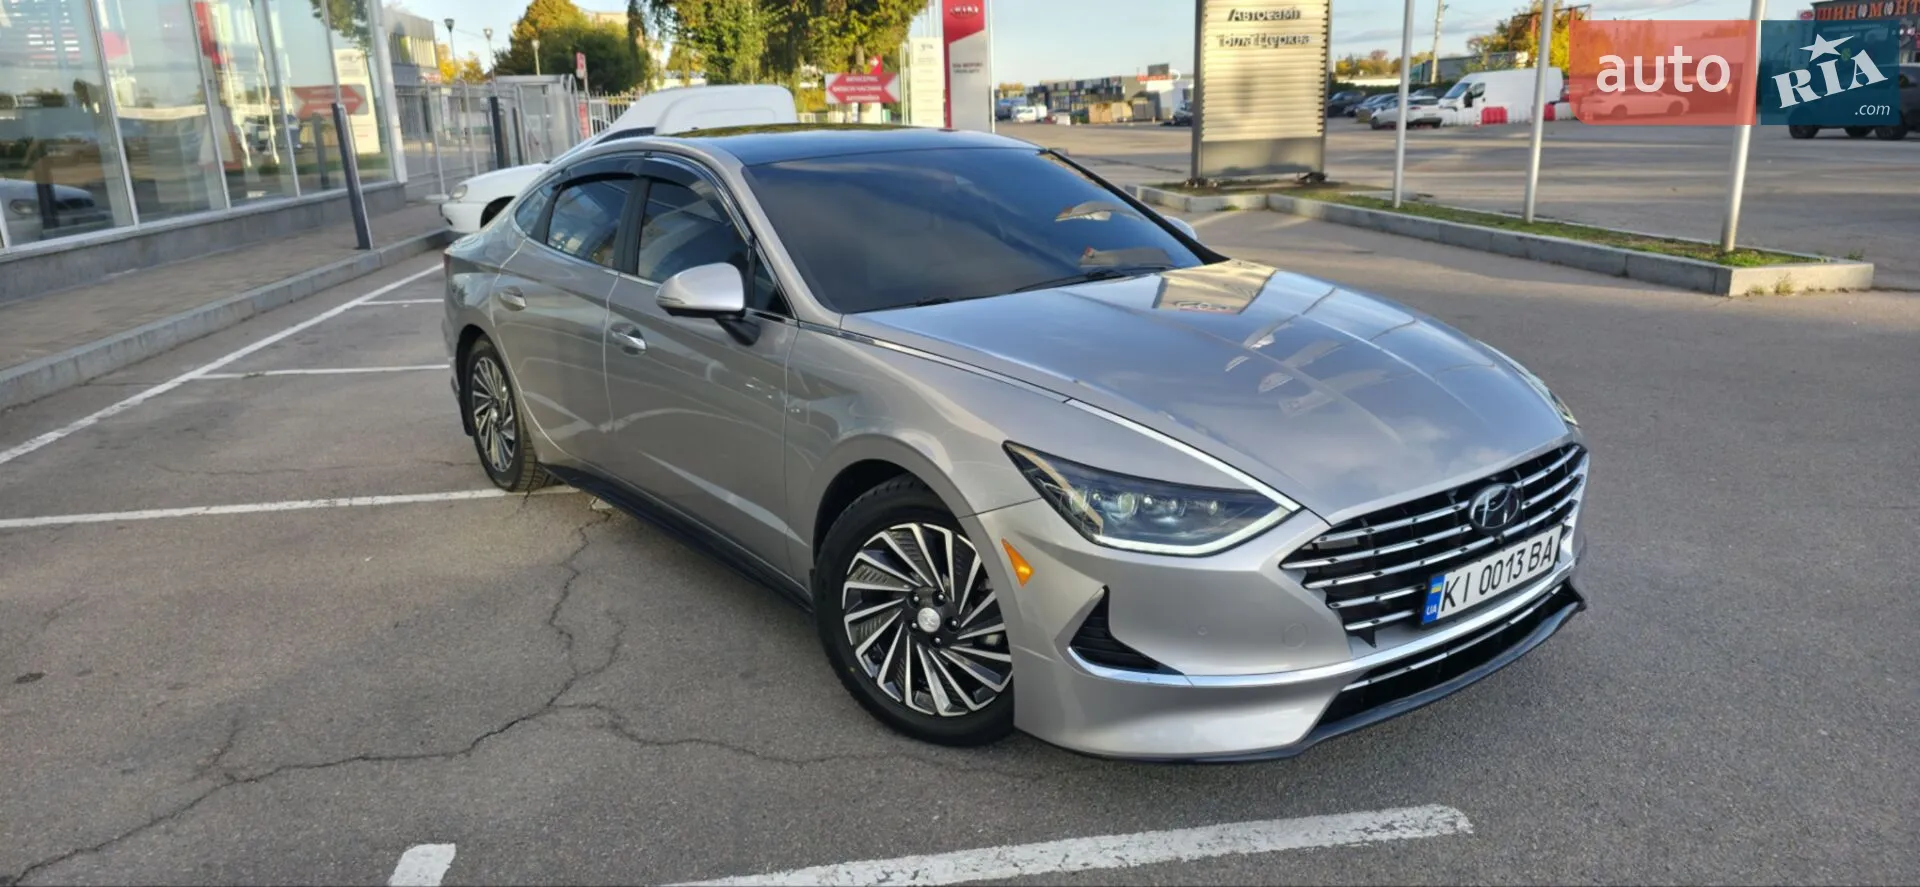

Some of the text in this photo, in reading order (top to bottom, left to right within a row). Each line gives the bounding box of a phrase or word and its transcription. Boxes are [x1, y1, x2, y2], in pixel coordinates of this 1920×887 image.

[1441, 535, 1553, 612] KI 0013 BA
[1426, 605, 1437, 615] UA
